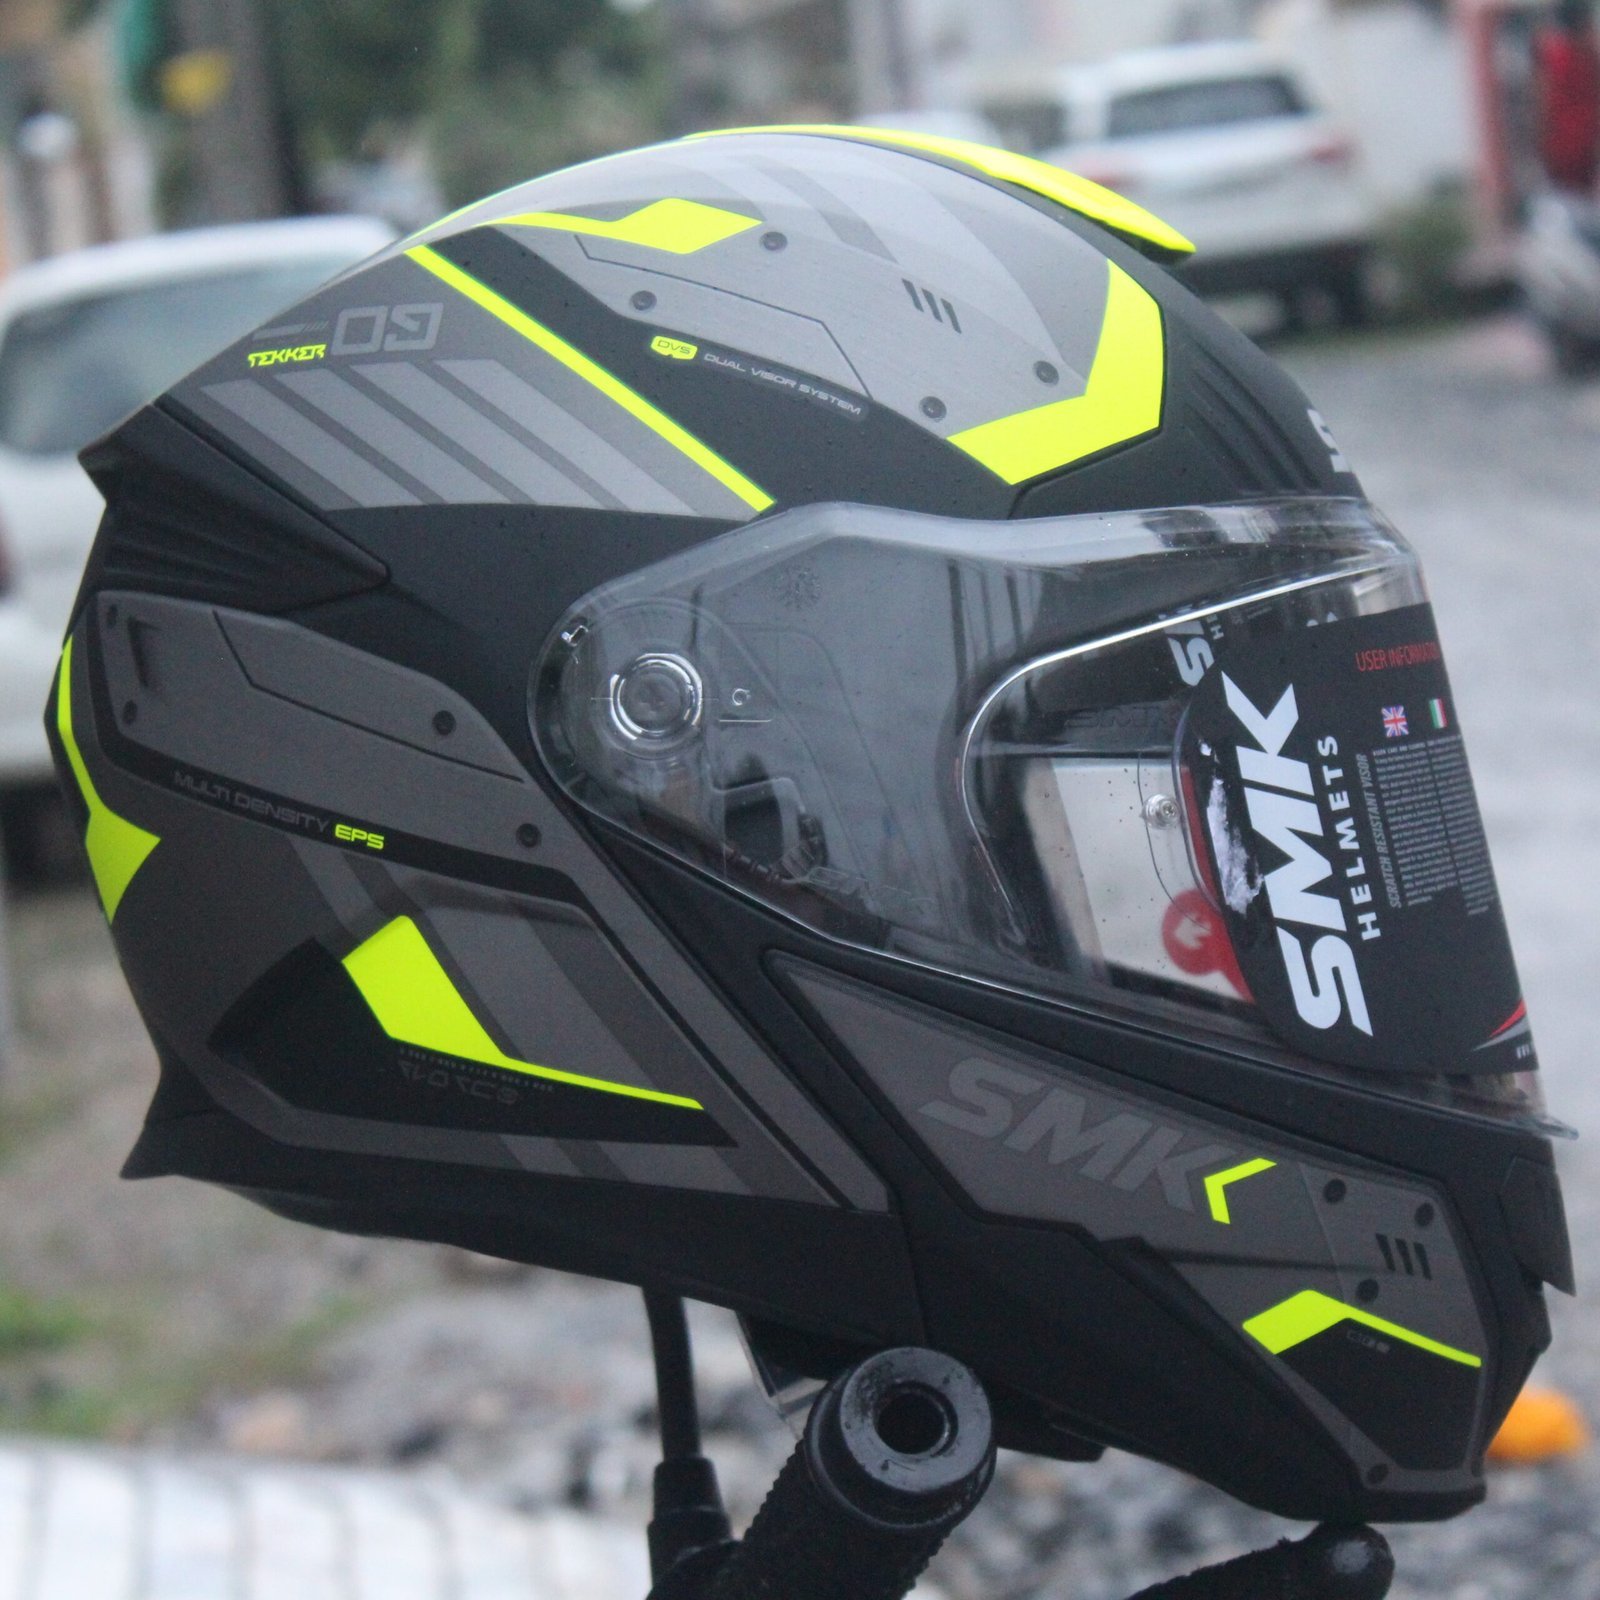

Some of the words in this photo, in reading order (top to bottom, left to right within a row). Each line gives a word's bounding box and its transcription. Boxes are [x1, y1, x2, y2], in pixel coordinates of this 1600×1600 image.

[248, 344, 327, 368] TEKKER
[331, 302, 444, 356] 09
[656, 339, 692, 356] DVS
[703, 352, 747, 373] DUAL
[750, 366, 798, 389] VISOR
[798, 382, 862, 416] SYSTEM
[1355, 648, 1389, 672] USER
[1355, 753, 1374, 788] VISOR
[174, 770, 231, 801] MULTI
[234, 791, 331, 834] DENSITY
[334, 823, 385, 851] EPS
[1317, 735, 1382, 941] HELMETS
[1363, 790, 1389, 855] RESISTANT
[1220, 670, 1374, 1037] SMK
[1378, 855, 1402, 909] SCRATCH
[917, 1056, 1238, 1214] SMK
